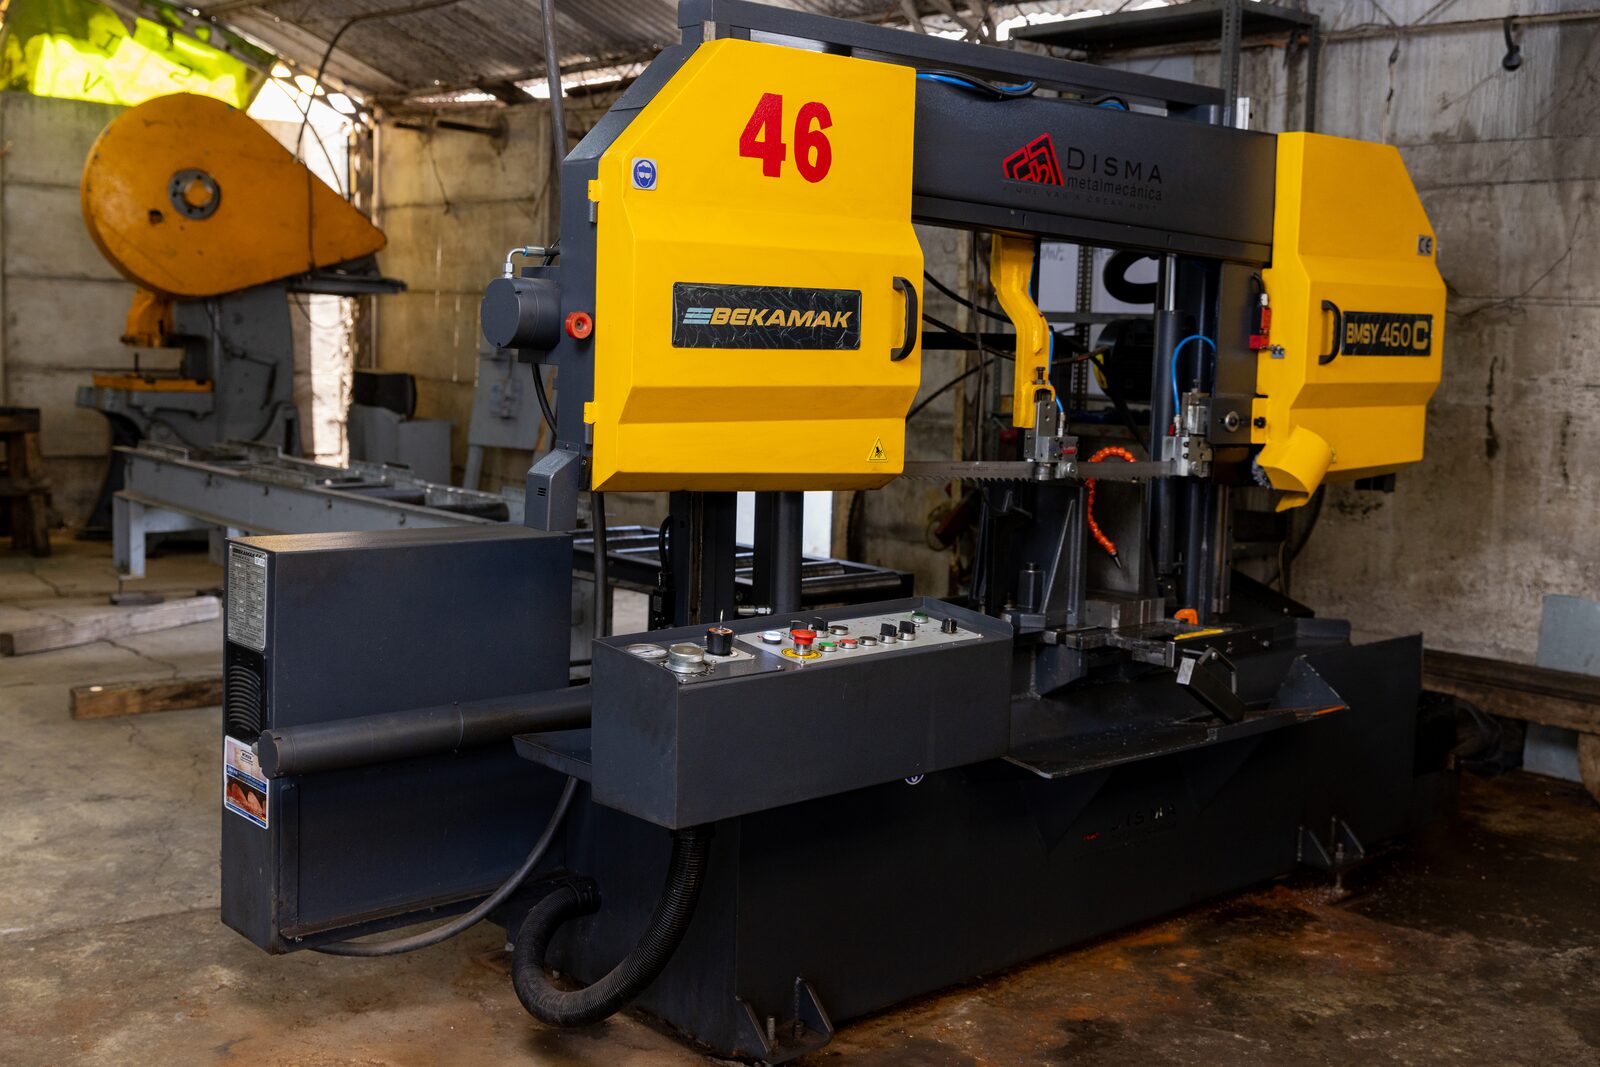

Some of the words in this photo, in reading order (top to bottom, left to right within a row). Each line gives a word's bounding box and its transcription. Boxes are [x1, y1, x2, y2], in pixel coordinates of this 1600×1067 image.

[739, 92, 833, 184] 46
[1067, 147, 1163, 185] DISMA
[709, 307, 853, 328] BEKAMAK
[1346, 322, 1379, 344] BMSY
[1380, 322, 1412, 348] 460
[1412, 320, 1429, 350] C
